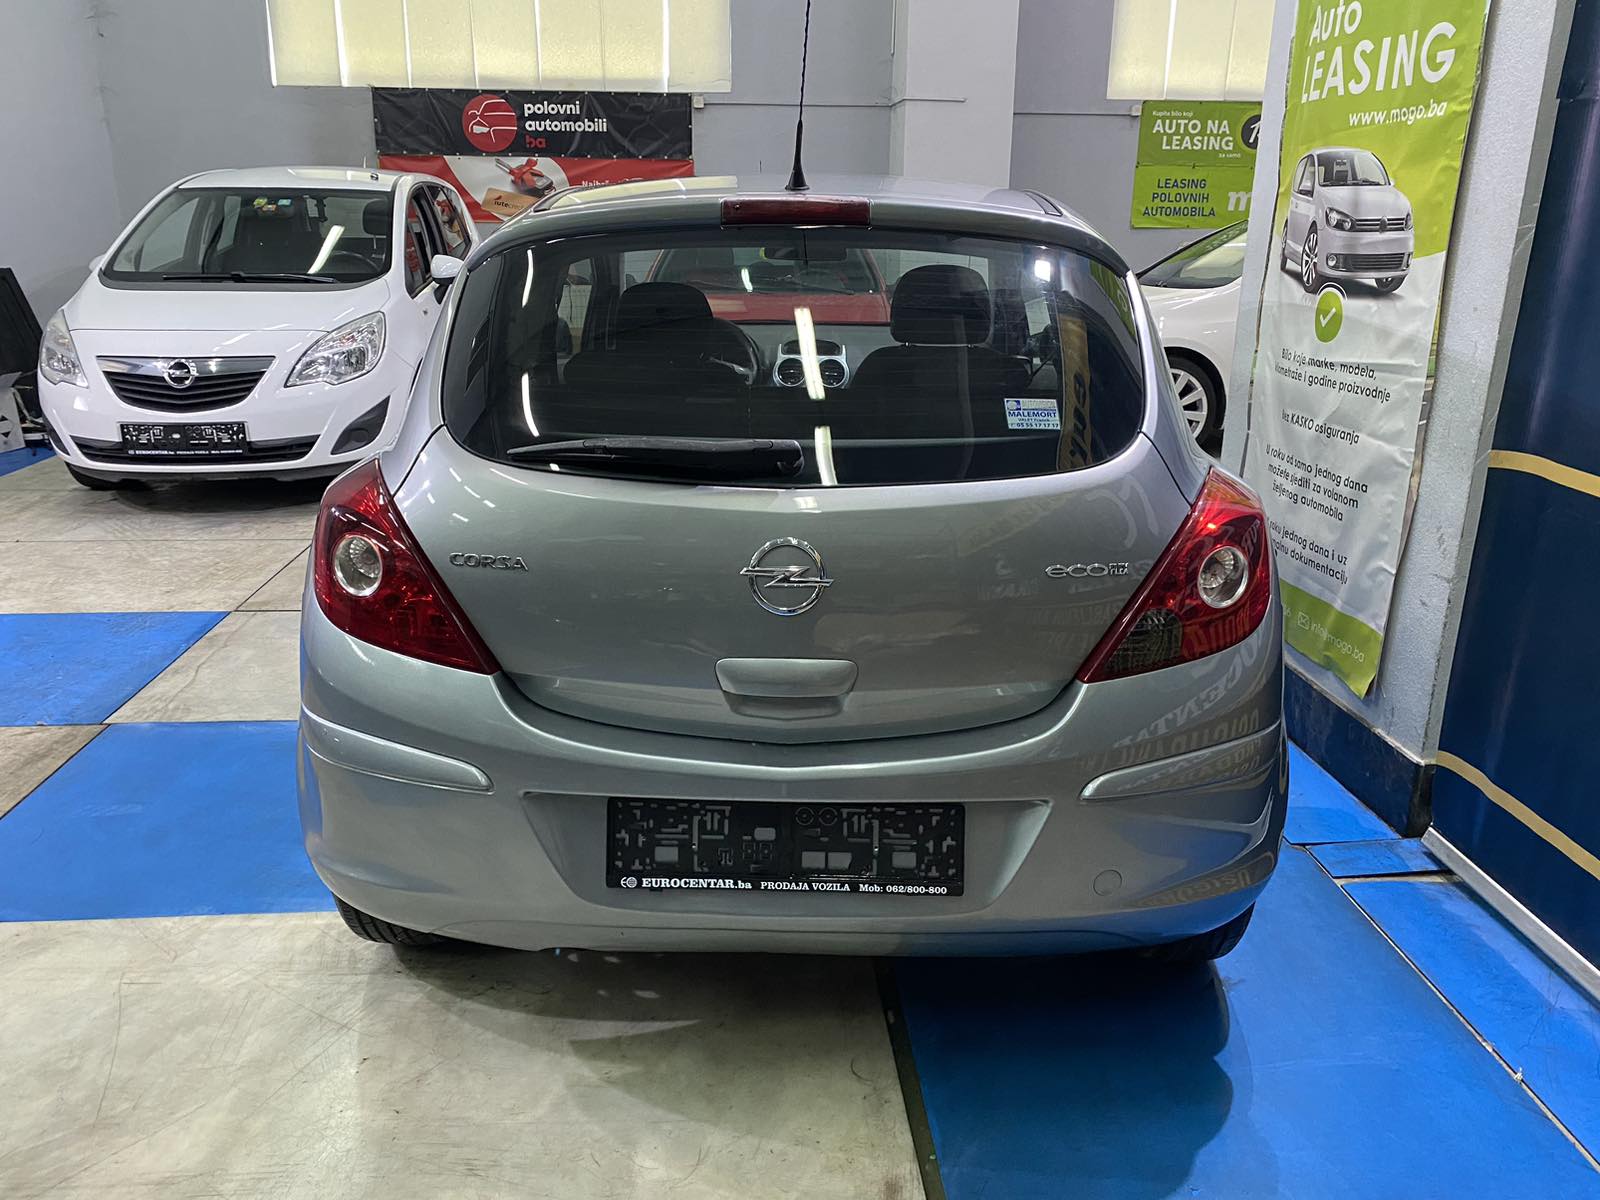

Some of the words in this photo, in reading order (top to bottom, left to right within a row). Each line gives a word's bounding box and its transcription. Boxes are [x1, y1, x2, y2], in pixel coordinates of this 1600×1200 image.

[1309, 0, 1362, 47] Auto
[1301, 22, 1456, 104] LEASING
[524, 101, 580, 117] polovni
[1349, 99, 1448, 126] www.mogo.ba
[525, 118, 607, 132] automobili
[1152, 119, 1201, 134] AUTO
[1206, 120, 1229, 134] NA
[1162, 135, 1234, 150] LEASING
[1157, 178, 1206, 189] LEASING
[1152, 193, 1209, 203] POLOVNIH
[1142, 206, 1216, 217] AUTOMOBILA
[1293, 351, 1306, 366] koje
[1340, 363, 1376, 380] modela,
[1308, 375, 1337, 389] godine
[1338, 382, 1391, 403] proizvodnje
[1291, 413, 1314, 430] KASKO
[1314, 423, 1360, 445] osiguranja
[1266, 444, 1270, 454] U
[1270, 448, 1285, 461] roku
[1286, 455, 1294, 465] od
[1294, 459, 1312, 473] samo
[1314, 464, 1342, 487] jednog
[1343, 476, 1368, 493] dana
[1268, 464, 1289, 481] možete
[1312, 482, 1321, 493] za
[1323, 487, 1359, 508] volanom
[1300, 495, 1343, 521] automobila
[1282, 526, 1307, 550] jednog
[1308, 541, 1329, 558] dana
[1331, 549, 1335, 560] i
[1337, 554, 1348, 566] uz
[449, 552, 528, 571] CORSA
[641, 877, 752, 889] EUROCENTAR.ba
[760, 881, 810, 890] PRODAJA
[812, 882, 850, 892] VOZILA
[859, 883, 883, 893] Mob:
[886, 884, 948, 895] 062/800-800
